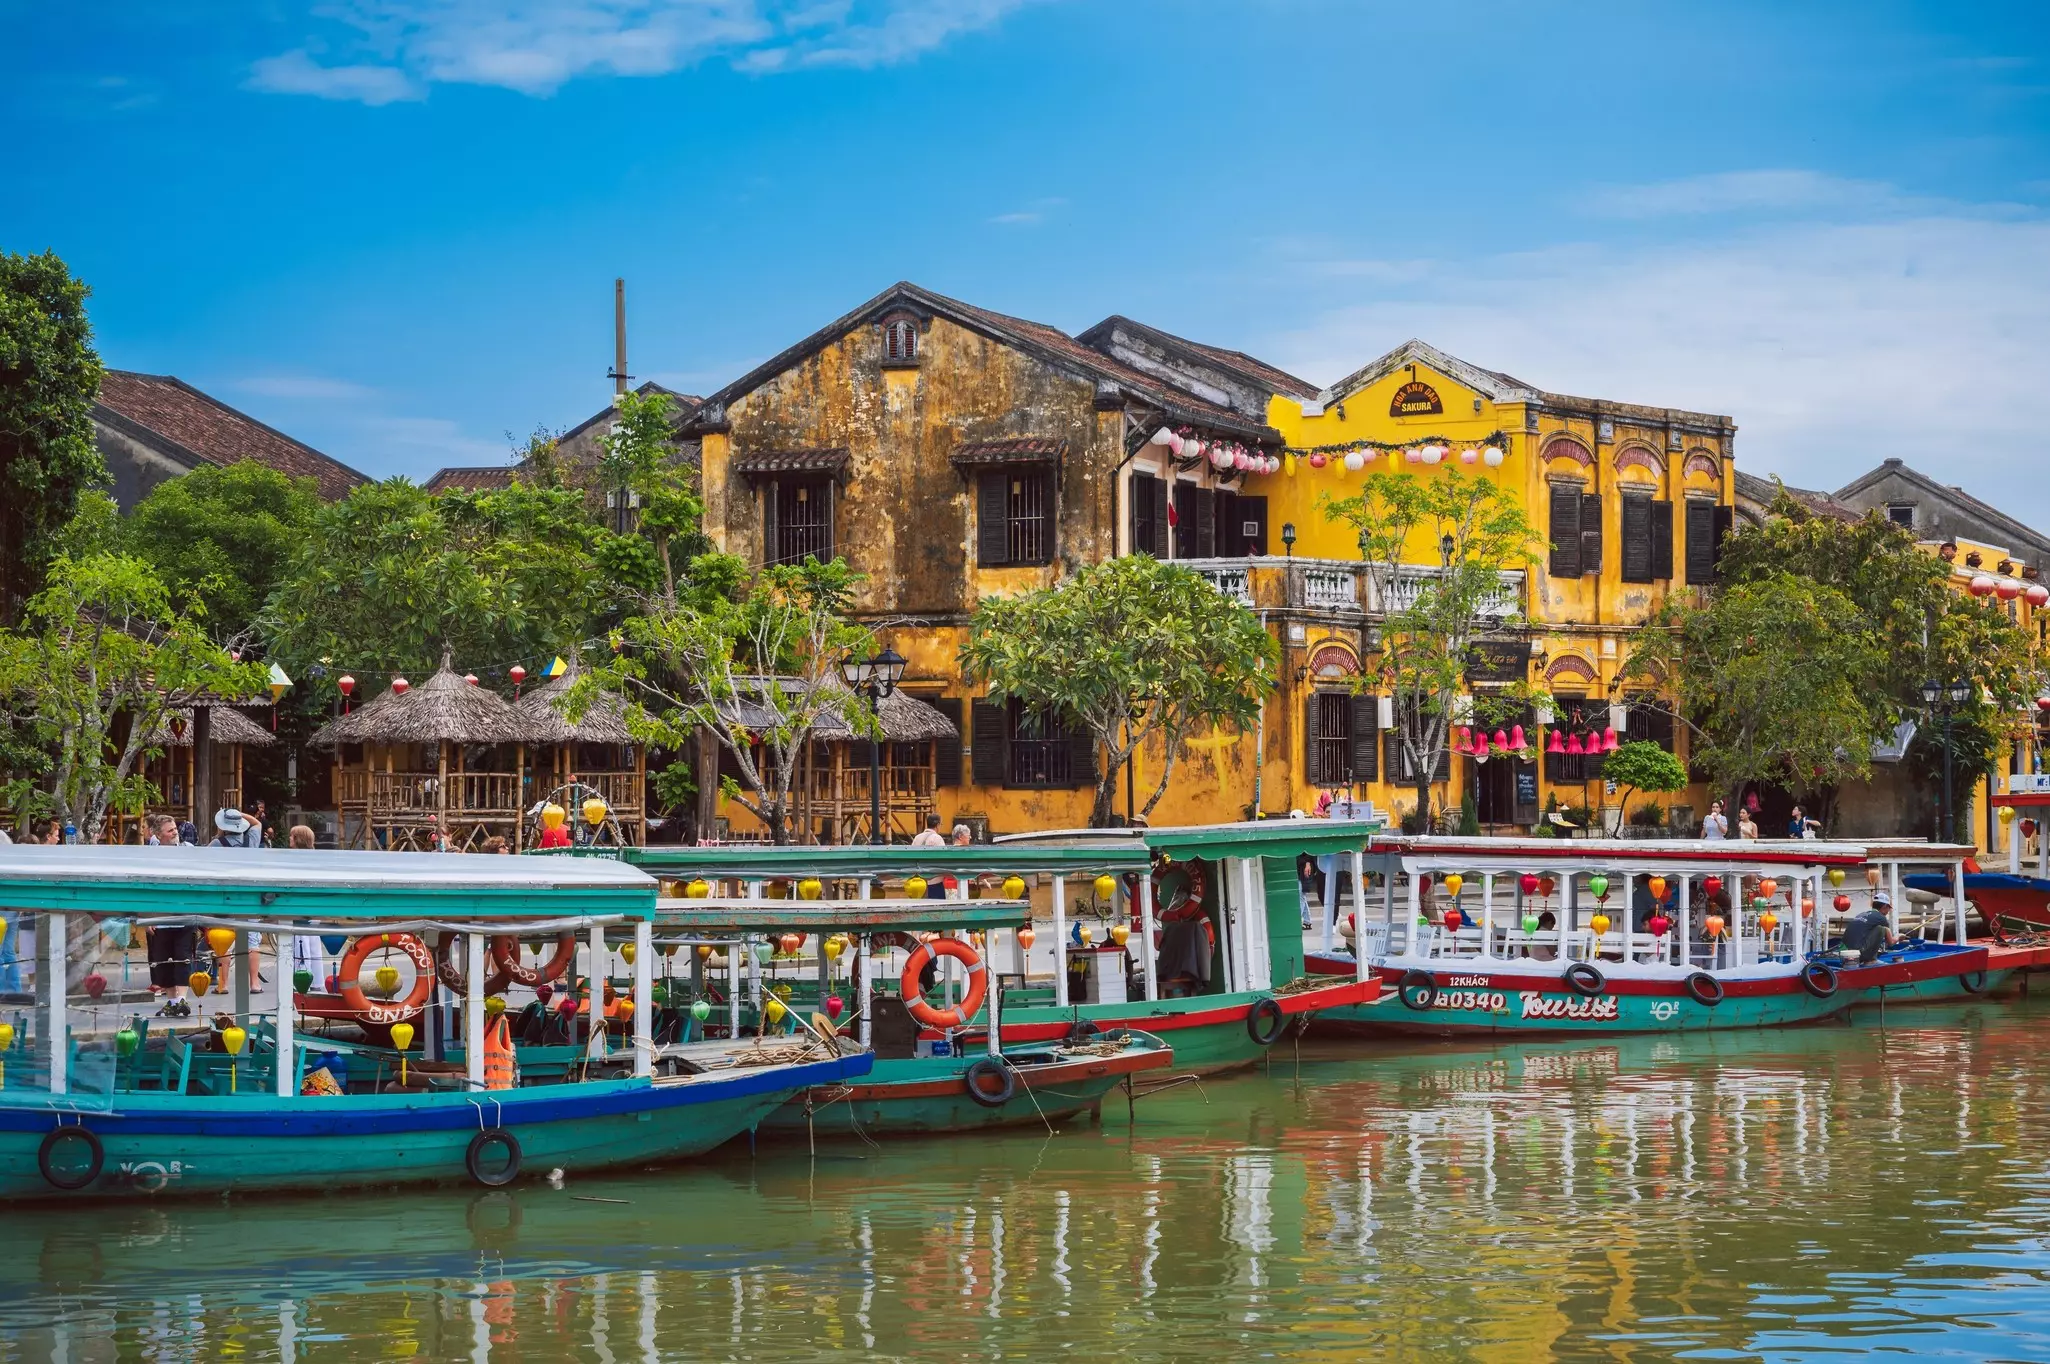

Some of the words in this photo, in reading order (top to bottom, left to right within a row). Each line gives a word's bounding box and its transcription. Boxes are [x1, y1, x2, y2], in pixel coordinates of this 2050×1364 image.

[1393, 391, 1407, 407] HOA
[1406, 383, 1424, 393] ANH
[1401, 402, 1432, 412] SAKURA
[1519, 991, 1619, 1019] Tourist
